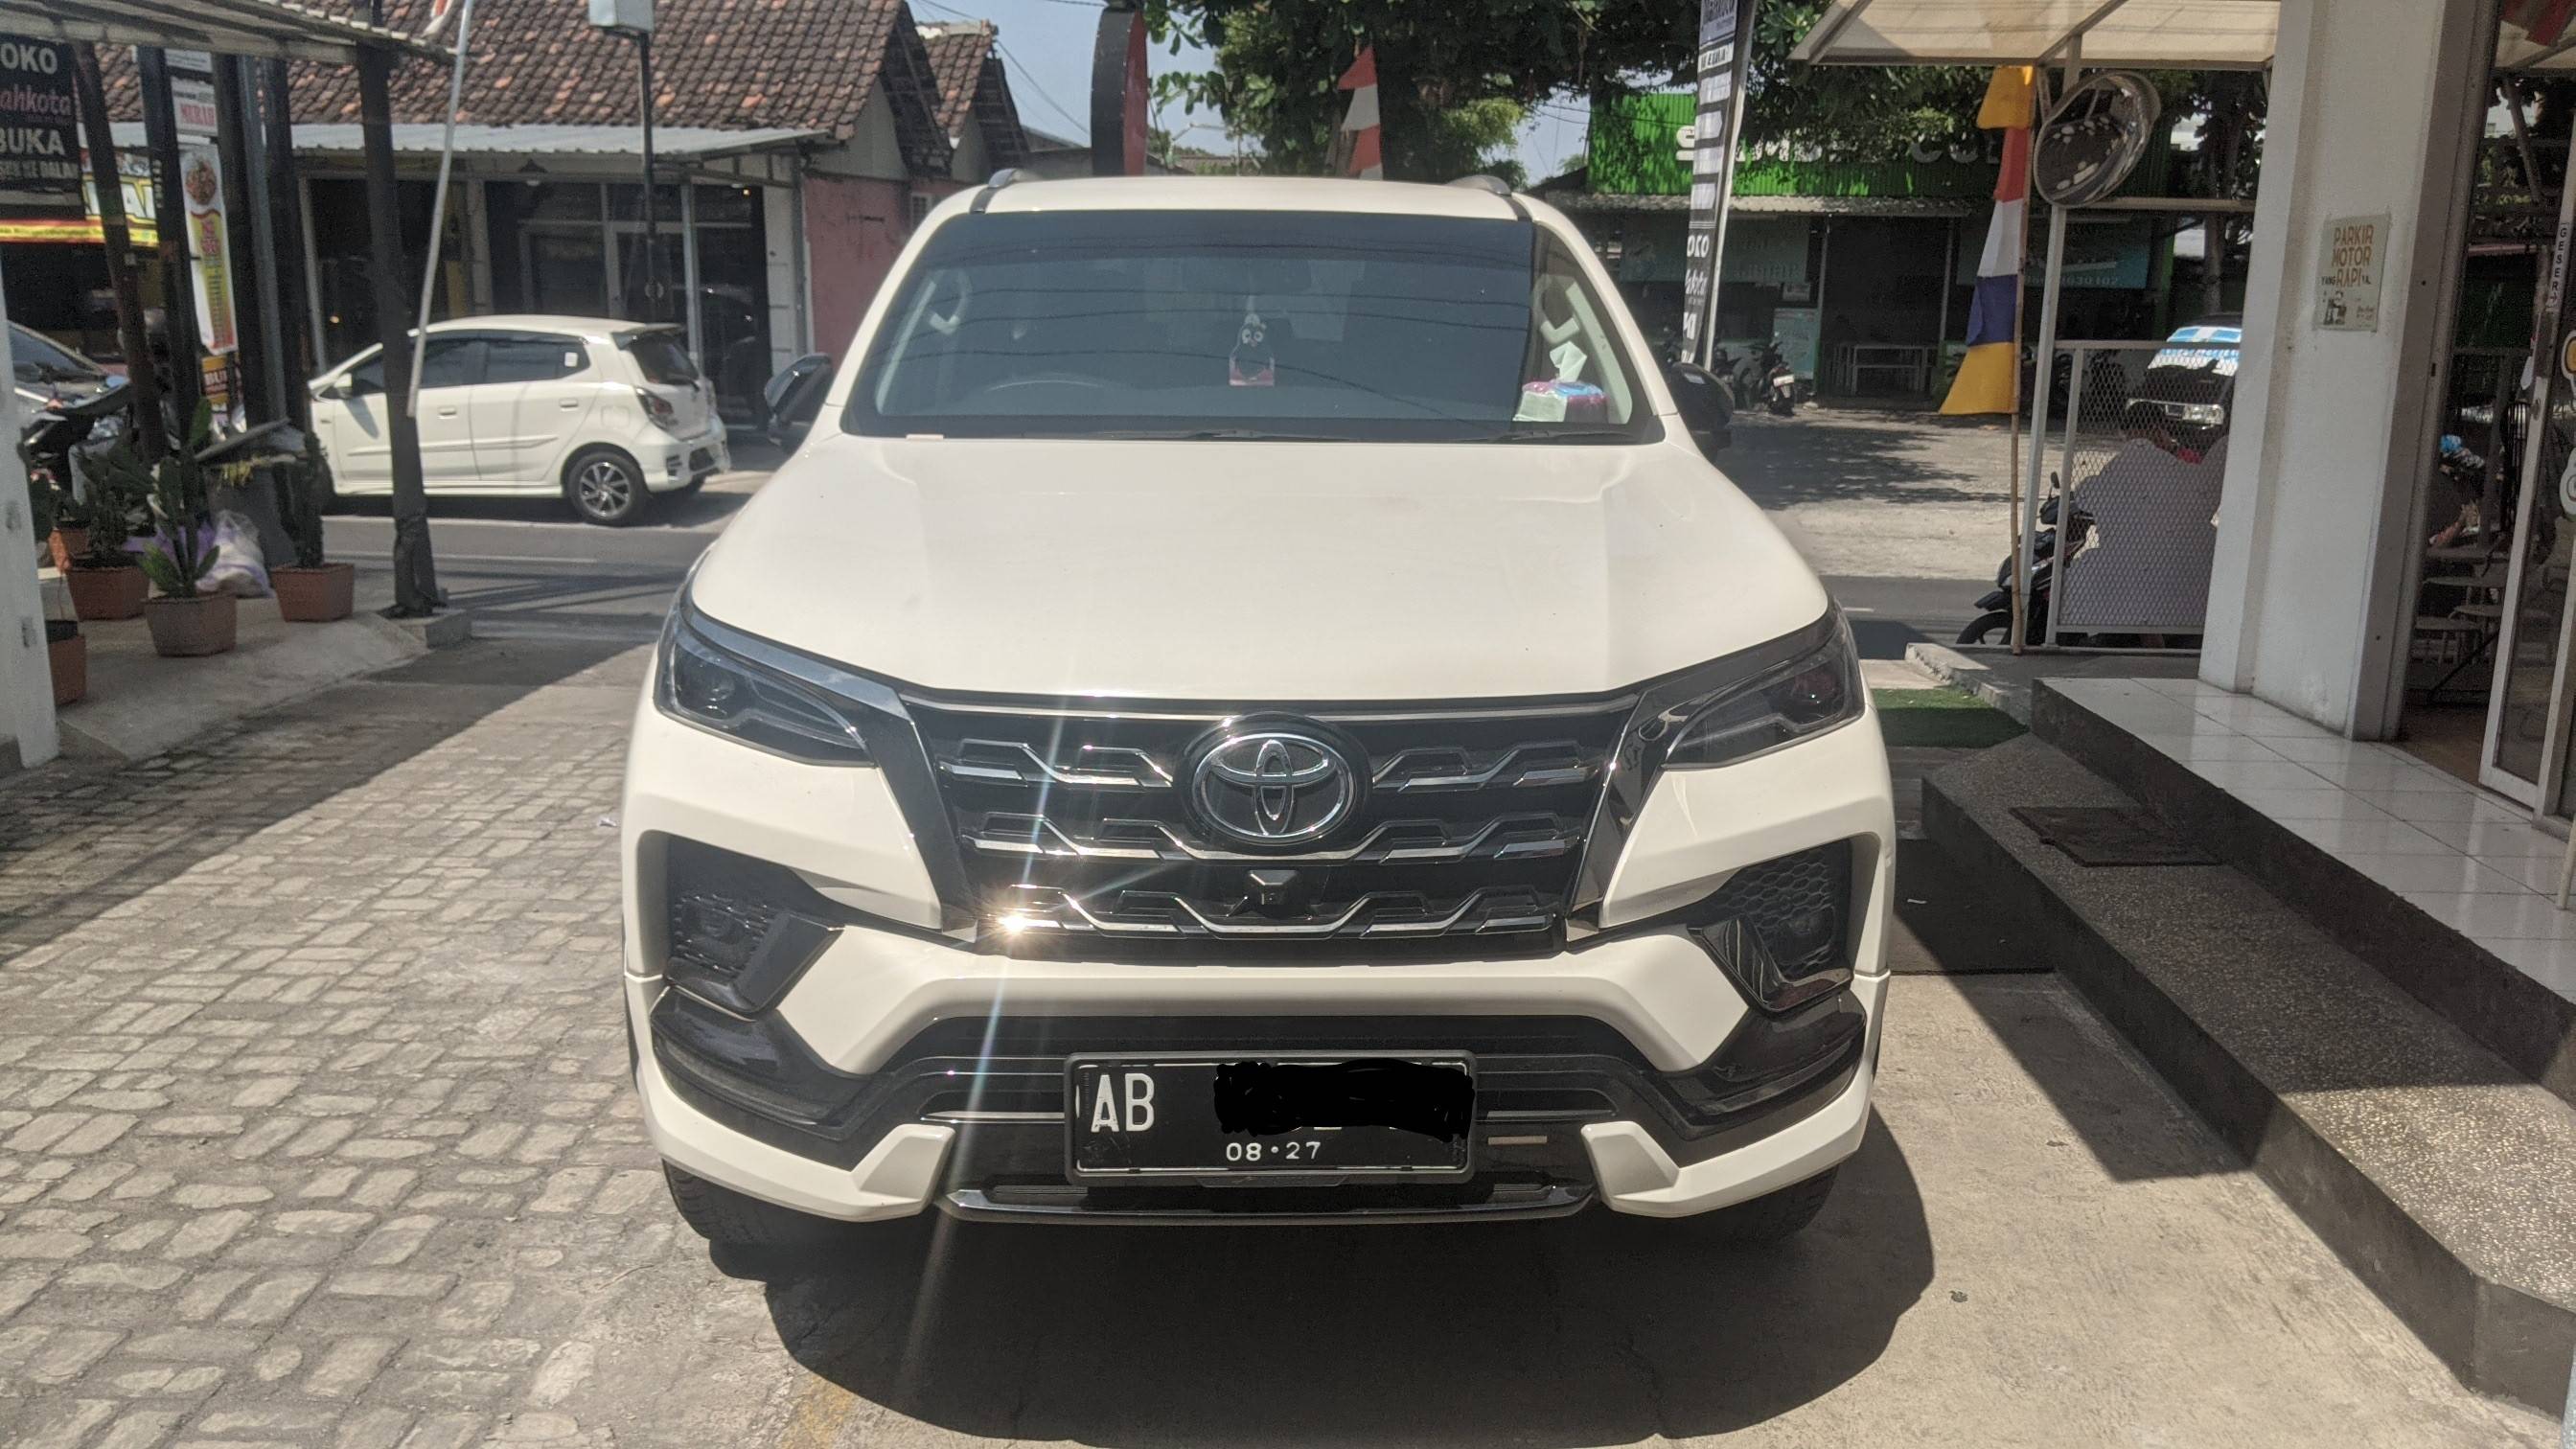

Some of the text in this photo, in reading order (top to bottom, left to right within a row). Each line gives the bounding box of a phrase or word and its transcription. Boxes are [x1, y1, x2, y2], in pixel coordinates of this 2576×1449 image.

[0, 42, 58, 75] OKO
[0, 82, 72, 116] ahkota
[2334, 224, 2375, 246] PARKIR
[2331, 246, 2373, 267] MOTOR
[2551, 228, 2567, 291] GESER
[2335, 267, 2362, 288] RAPI
[1091, 1072, 1155, 1133] AB
